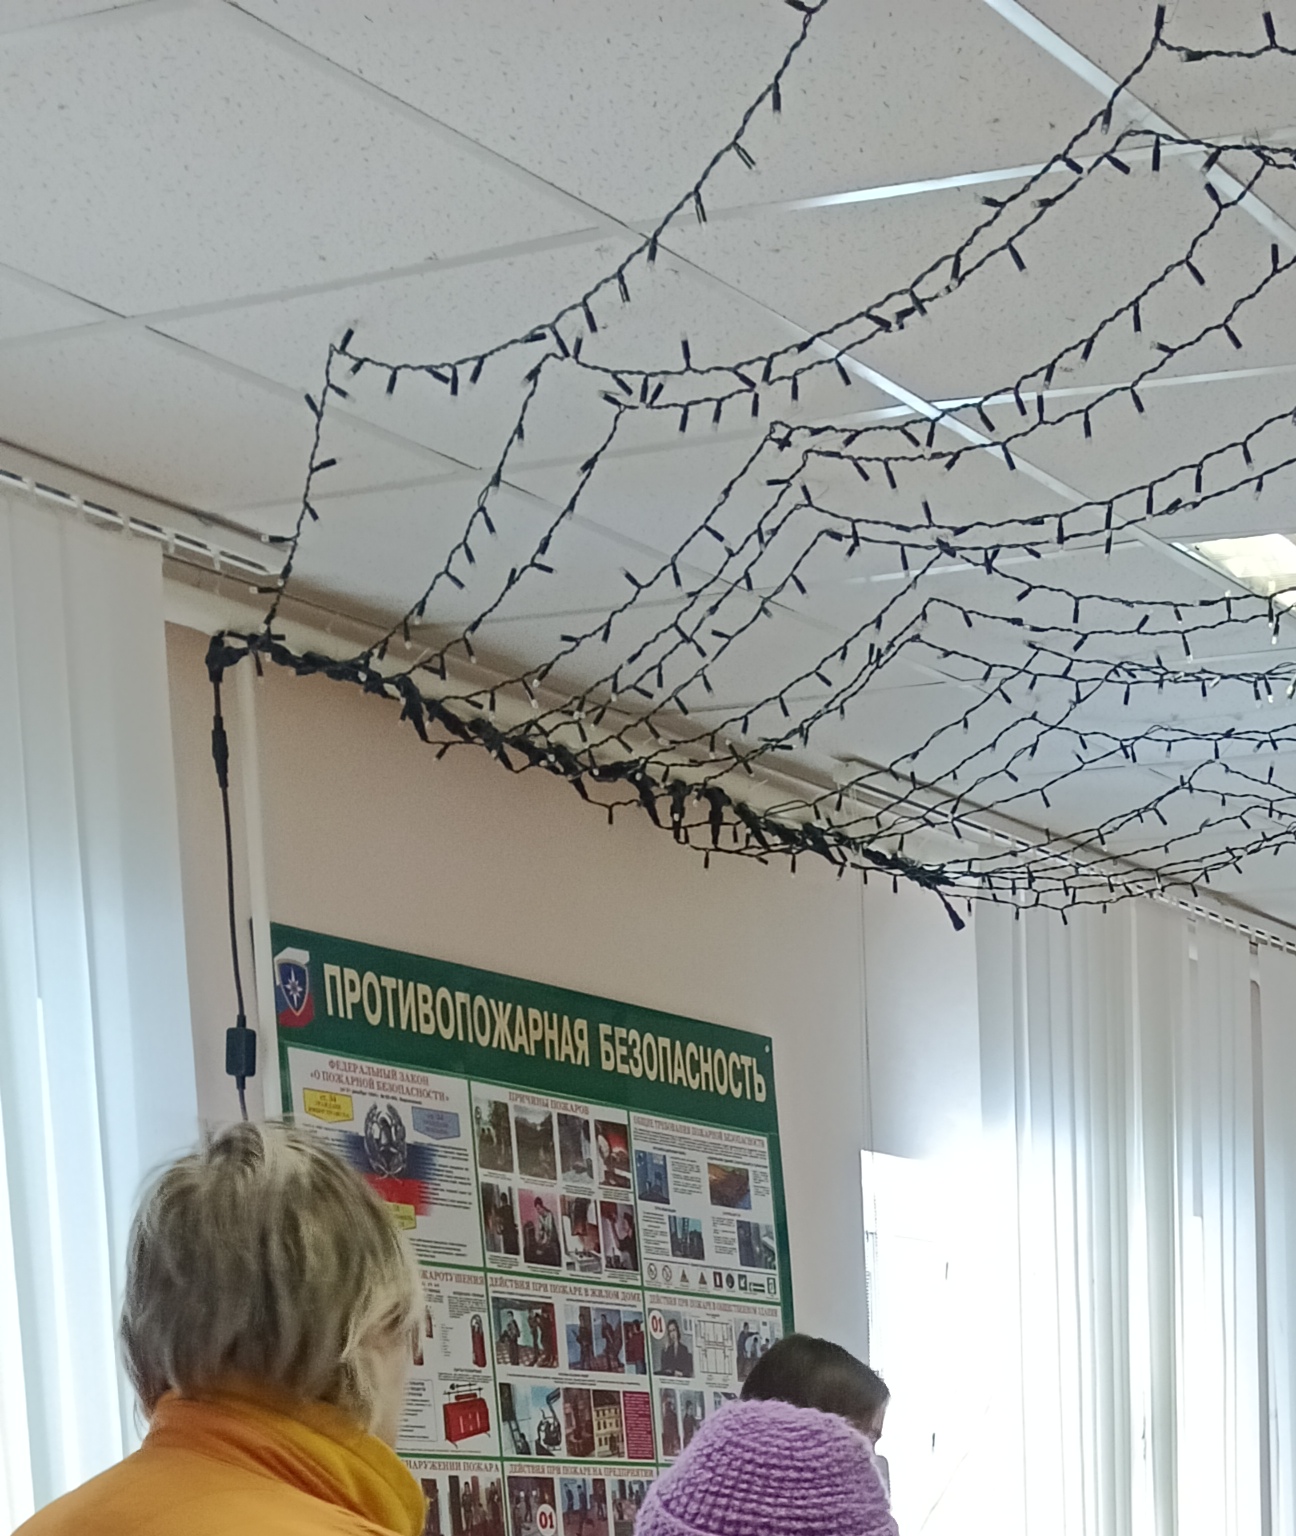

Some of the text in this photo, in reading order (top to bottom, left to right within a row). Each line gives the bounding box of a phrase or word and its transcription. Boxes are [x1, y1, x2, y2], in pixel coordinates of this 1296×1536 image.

[323, 963, 767, 1103] ПРОТИВОПОЖАРНАЯ БЕЗОПАСНОСТЬ
[322, 1071, 375, 1090] ПОЖАРНОЙ
[328, 1059, 429, 1086] ФЕДЕРАЛЬНЫЙ ЗАКОН
[508, 1091, 590, 1115] ПРИЧИНЫ ПОЖАРОВ
[421, 1269, 484, 1285] ЖАРОТУШЕНИЯ
[489, 1276, 531, 1289] ДЕЙСТВИЯ
[532, 1281, 549, 1293] ПРИ
[549, 1283, 584, 1297] ПОЖАРЕ
[590, 1288, 620, 1300] ЖИЛОМ
[620, 1291, 642, 1302] ДОМЕ
[651, 1314, 663, 1333] 01
[404, 1458, 500, 1473] НАРУЖЕНИИ ПОЖАРА
[508, 1463, 546, 1475] ДЕЙСТВИЯ
[546, 1465, 562, 1475] ПРИ
[562, 1466, 589, 1476] ПОЖАРЕ
[589, 1467, 603, 1477] НА
[539, 1510, 555, 1530] 01
